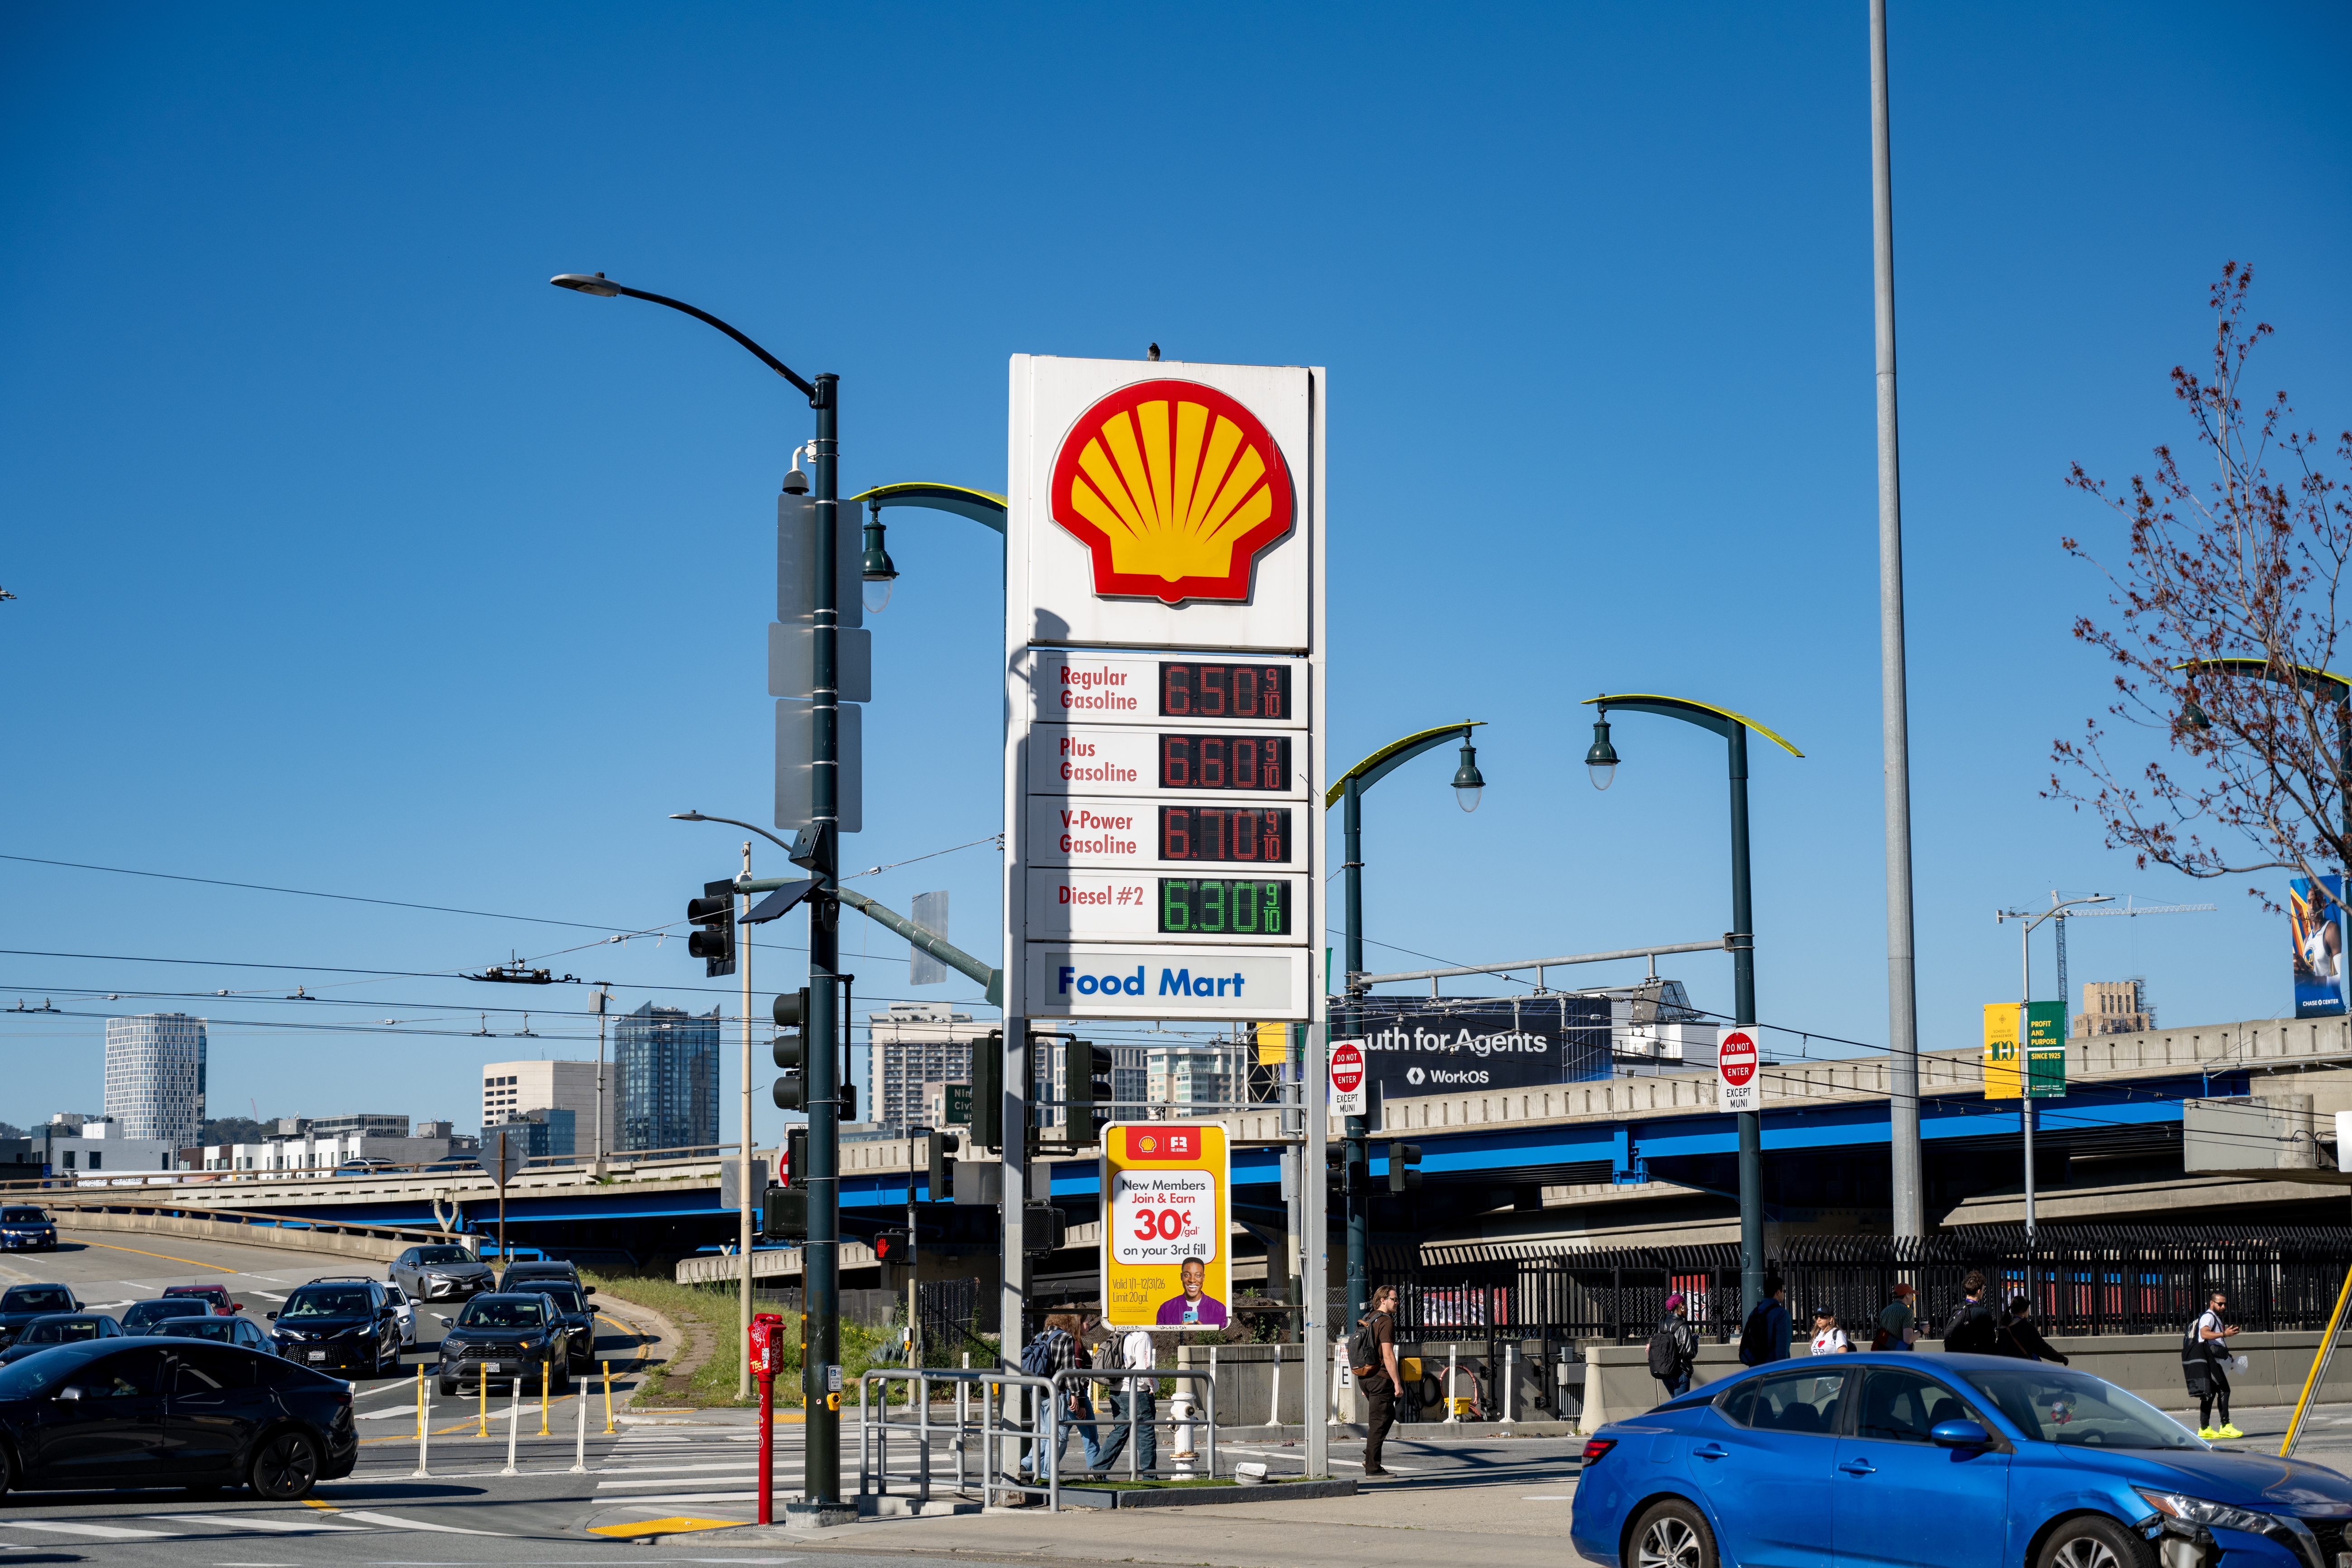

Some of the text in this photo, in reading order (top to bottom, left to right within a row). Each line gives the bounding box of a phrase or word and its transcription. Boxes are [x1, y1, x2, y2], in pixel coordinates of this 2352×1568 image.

[1061, 666, 1127, 690] Regular
[1165, 666, 1257, 715] 6.50
[1061, 690, 1137, 710] Gasoline
[1060, 737, 1095, 756] Plus
[1165, 737, 1257, 787] 6.60
[1060, 762, 1137, 782] Gasoline
[1060, 810, 1133, 830] V-Power
[1060, 834, 1137, 854] Gasoline
[1059, 885, 1143, 905] Diesel #2
[1164, 881, 1257, 932] 6.30
[1059, 966, 1245, 997] Food Mart
[1363, 1027, 1547, 1057] uth for Agents
[1726, 1042, 1750, 1052] DO NOT
[1337, 1053, 1357, 1062] DO NOT
[1990, 1040, 2015, 1061] 100
[1430, 1070, 1489, 1084] WorkOS
[1727, 1067, 1749, 1076] ENTER
[1338, 1076, 1357, 1084] ENTER
[954, 1089, 970, 1097] Nin
[1337, 1094, 1358, 1103] EXCEPT
[1726, 1087, 1751, 1097] EXCEPT
[954, 1101, 972, 1110] Civ
[1340, 1104, 1355, 1113] MUNI
[1730, 1099, 1747, 1108] MUNI
[1122, 1179, 1205, 1190] New Members
[1132, 1193, 1195, 1204] Join & Earn
[1123, 1243, 1206, 1258] on your 3rd fill
[1112, 1278, 1127, 1289] Valid
[1113, 1292, 1128, 1302] Limit
[1342, 1366, 1349, 1385] E
